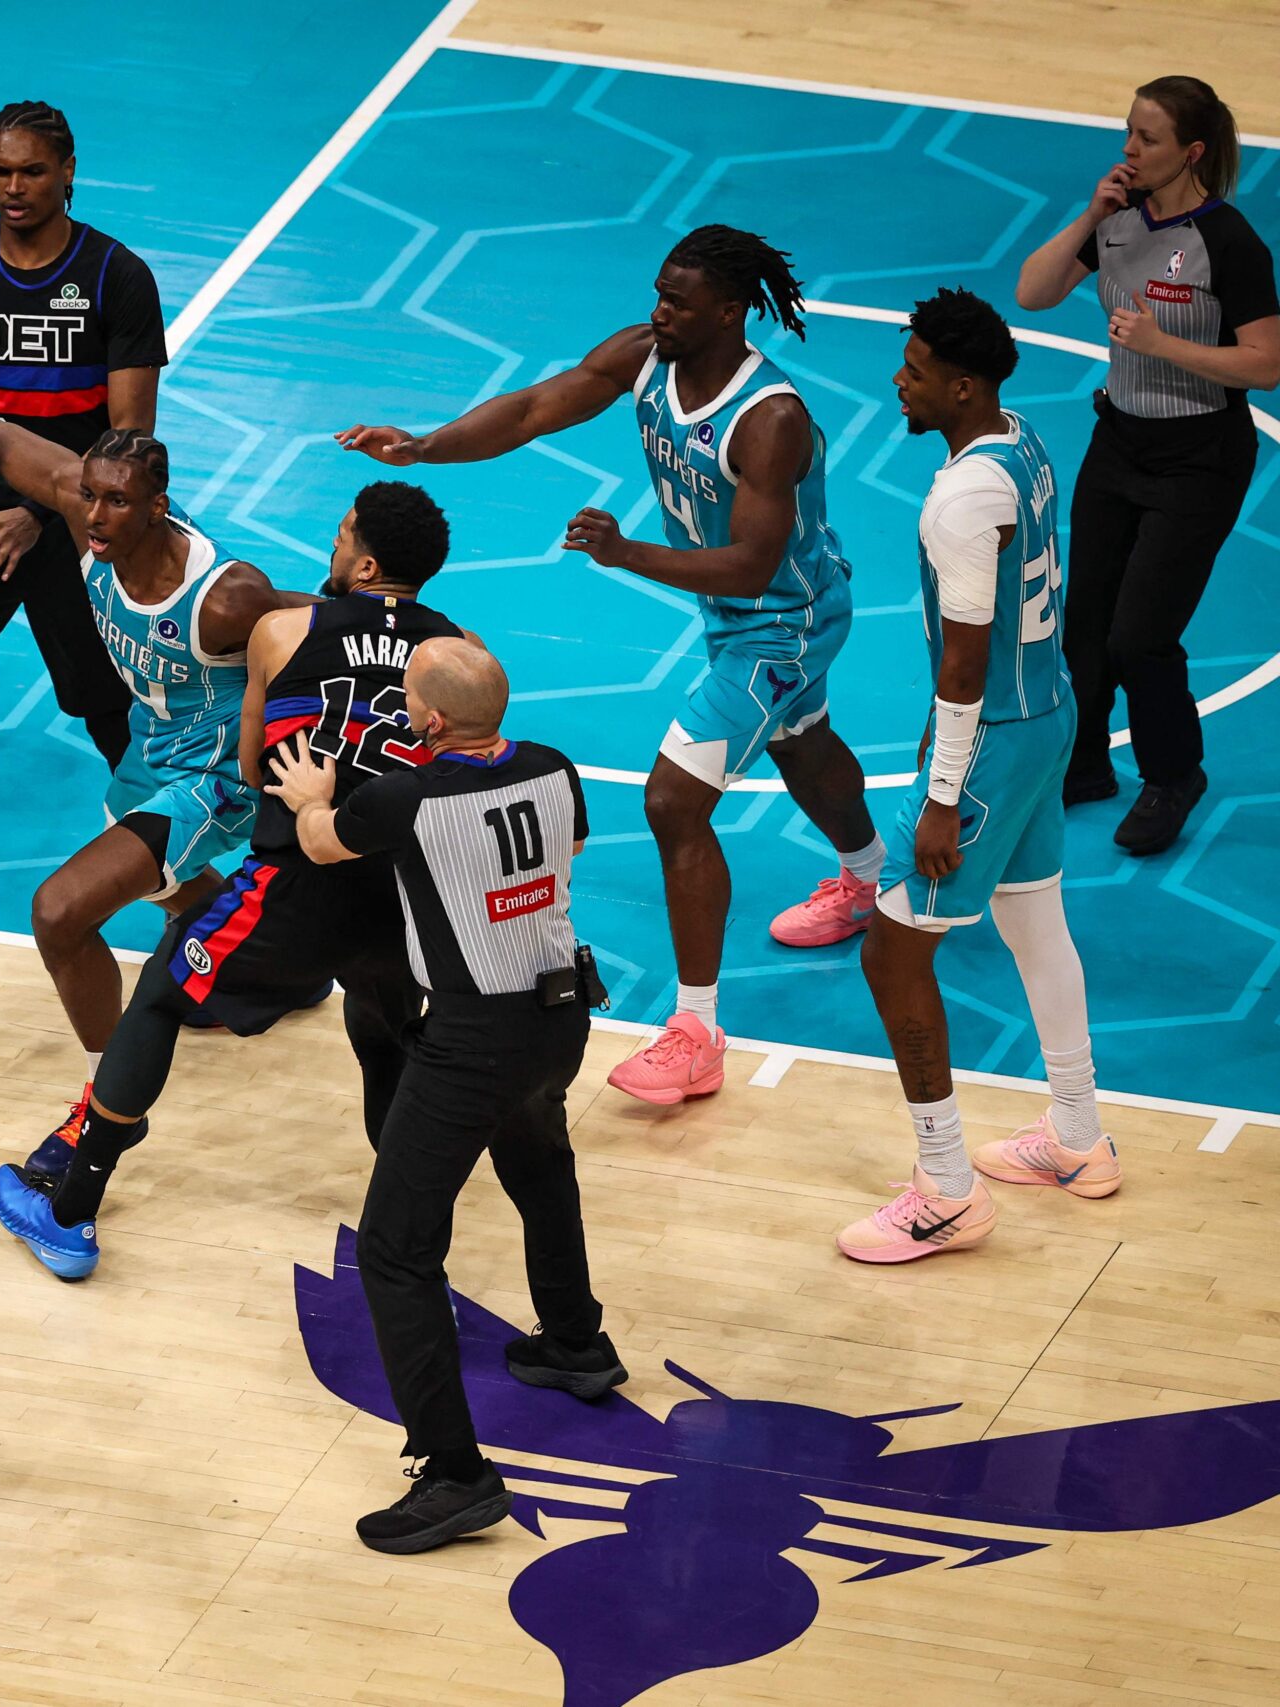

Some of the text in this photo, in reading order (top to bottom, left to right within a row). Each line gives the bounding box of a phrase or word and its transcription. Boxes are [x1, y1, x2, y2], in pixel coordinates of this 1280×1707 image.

[51, 300, 88, 308] StockX
[1146, 283, 1191, 300] Emirates
[661, 477, 702, 546] 4
[308, 676, 425, 777] 12
[484, 800, 545, 877] 10
[495, 886, 550, 914] Emirates
